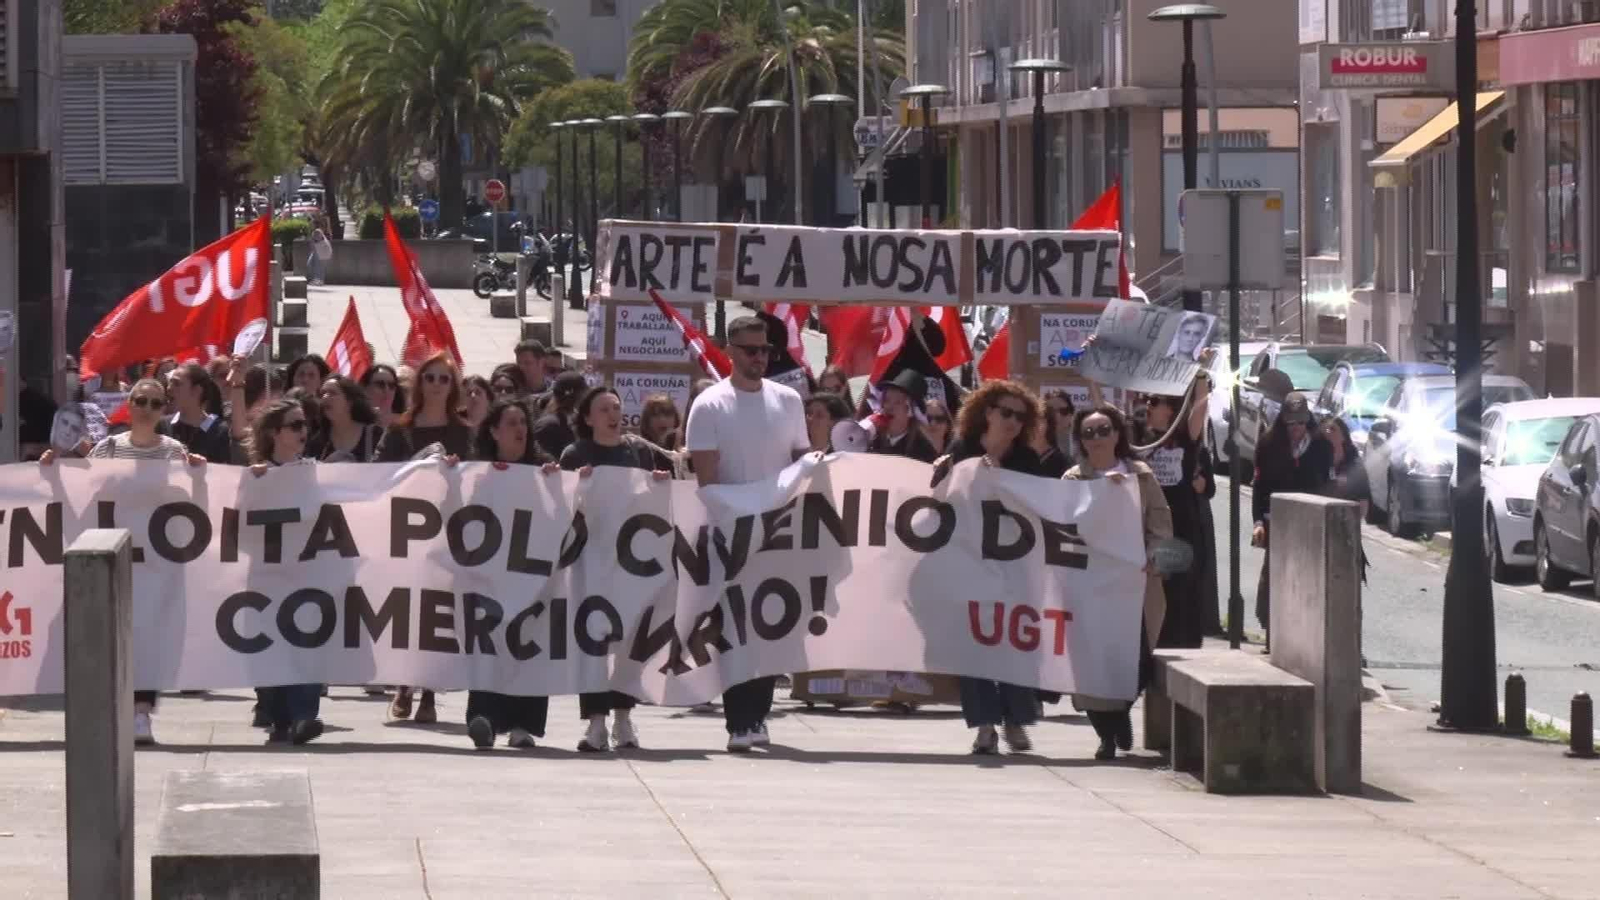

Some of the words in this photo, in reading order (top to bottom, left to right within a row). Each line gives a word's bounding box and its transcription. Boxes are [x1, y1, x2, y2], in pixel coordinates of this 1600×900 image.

[1340, 48, 1418, 67] ROBUR
[610, 234, 716, 293] ARTE
[736, 227, 766, 287] É
[774, 235, 808, 288] A
[843, 233, 957, 294] NOSA
[976, 237, 1120, 298] MORTE
[1043, 318, 1060, 328] NA
[617, 378, 633, 388] NA
[981, 499, 1089, 570] DE
[215, 585, 624, 660] COMERCIO
[968, 600, 1074, 656] UGT
